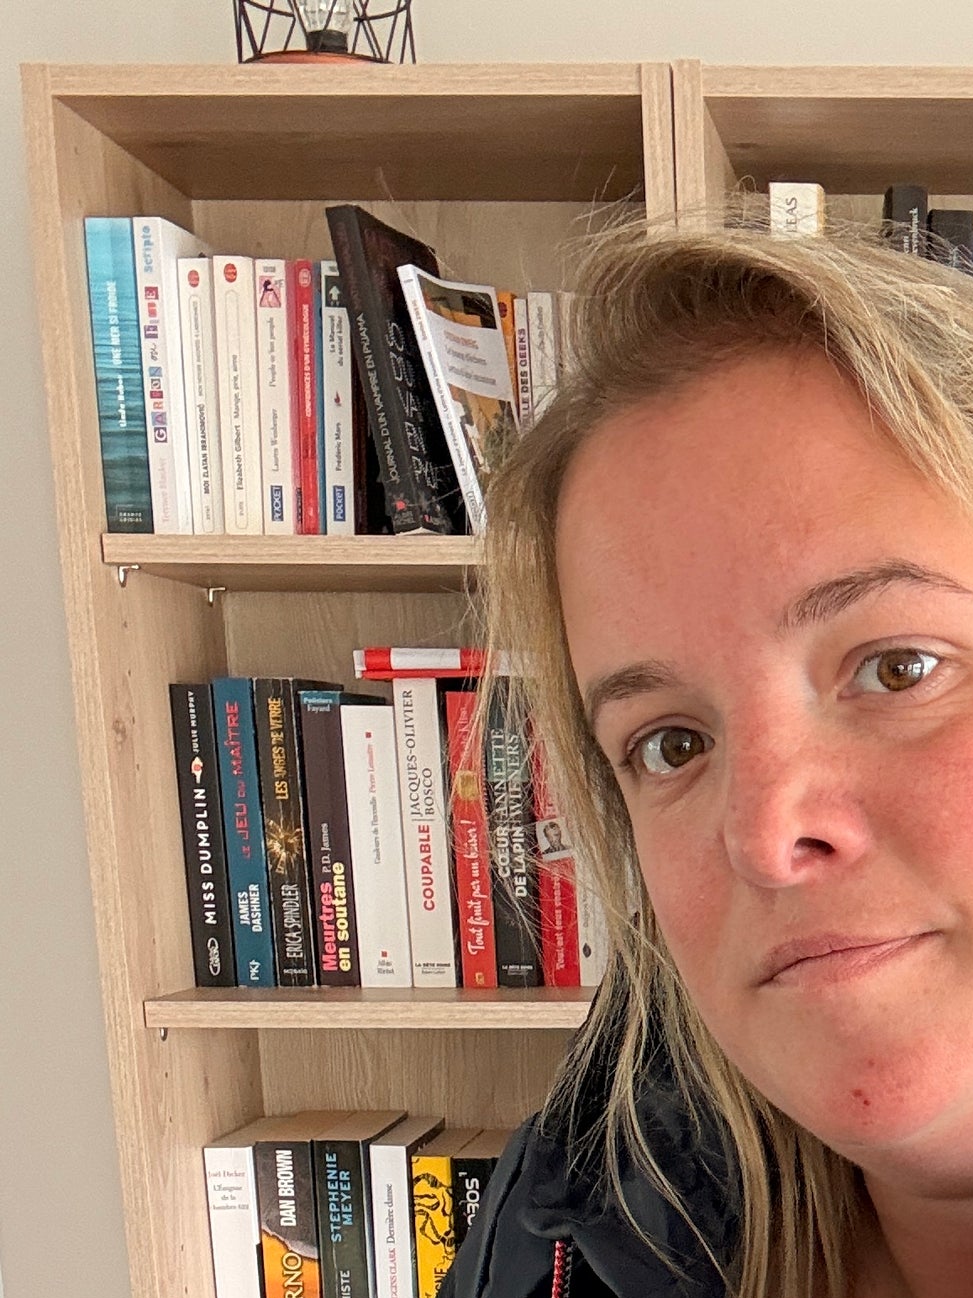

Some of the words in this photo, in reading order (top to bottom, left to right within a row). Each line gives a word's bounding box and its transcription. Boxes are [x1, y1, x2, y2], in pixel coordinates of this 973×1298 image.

[106, 281, 118, 313] FROIDE
[109, 316, 119, 325] SI
[110, 327, 121, 345] MER
[356, 313, 372, 354] PYJAMA
[364, 354, 376, 369] EN
[516, 329, 526, 367] GEEKS
[303, 372, 312, 418] CONFIDENCES
[518, 371, 528, 394] DES
[233, 425, 241, 452] Gilbert
[377, 412, 390, 437] D'UN
[200, 454, 209, 478] ZLATAN
[235, 454, 243, 490] Elizabeth
[382, 437, 401, 483] JOURNAL
[272, 486, 283, 521] POCKET
[268, 698, 283, 731] VERRE
[190, 730, 199, 754] JULIE
[223, 701, 244, 775] MAÎTRE
[402, 690, 421, 817] JACQUES-OLIVIER
[491, 729, 508, 816] ANNETTE
[273, 781, 288, 800] LES
[421, 768, 434, 815] BOSCO
[193, 788, 213, 874] DUMPLIN
[234, 803, 248, 840] JEU
[319, 823, 331, 851] James
[511, 826, 527, 873] LAPIN
[418, 825, 435, 911] COUPABLE
[470, 862, 480, 877] un
[201, 881, 217, 924] MISS
[331, 862, 349, 941] soutane
[471, 879, 485, 898] par
[515, 876, 527, 897] DE
[238, 892, 250, 926] JAMES
[248, 884, 263, 932] DASHNER
[281, 884, 301, 929] SPINDLER
[468, 901, 489, 926] finit
[319, 882, 337, 971] Meurtres
[468, 927, 485, 955] Tout
[285, 932, 303, 958] ERICA
[338, 945, 351, 971] en
[275, 1150, 295, 1197] BROWN
[326, 1153, 342, 1242] STEPHENIE
[340, 1170, 354, 1226] MEYER
[385, 1184, 394, 1207] danse
[279, 1200, 297, 1226] DAN
[385, 1209, 396, 1244] Dernière
[389, 1248, 397, 1275] CLARK
